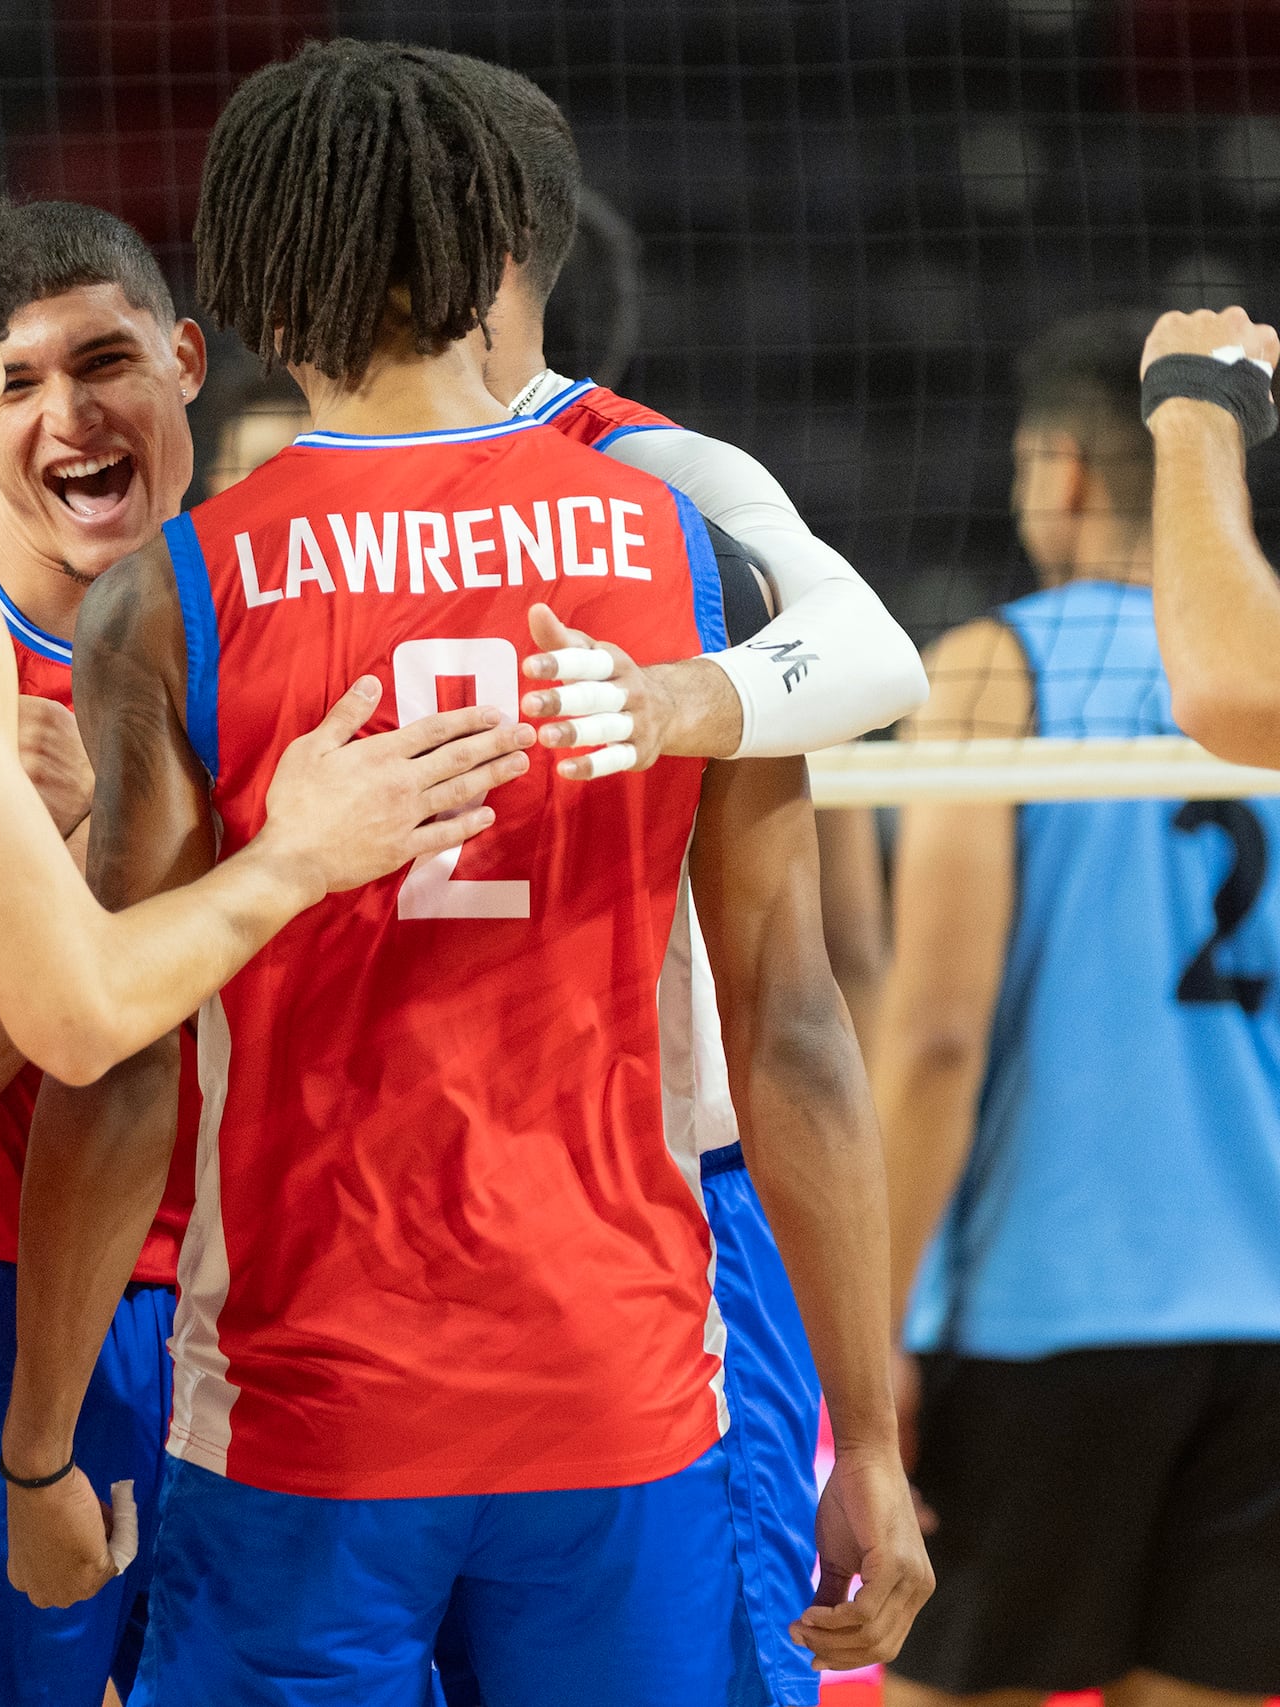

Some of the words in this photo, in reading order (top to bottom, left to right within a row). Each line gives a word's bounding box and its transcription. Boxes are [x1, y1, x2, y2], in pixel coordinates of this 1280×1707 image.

[234, 496, 652, 608] LAWRENCE
[393, 637, 531, 920] 2
[1172, 796, 1272, 1017] 2
